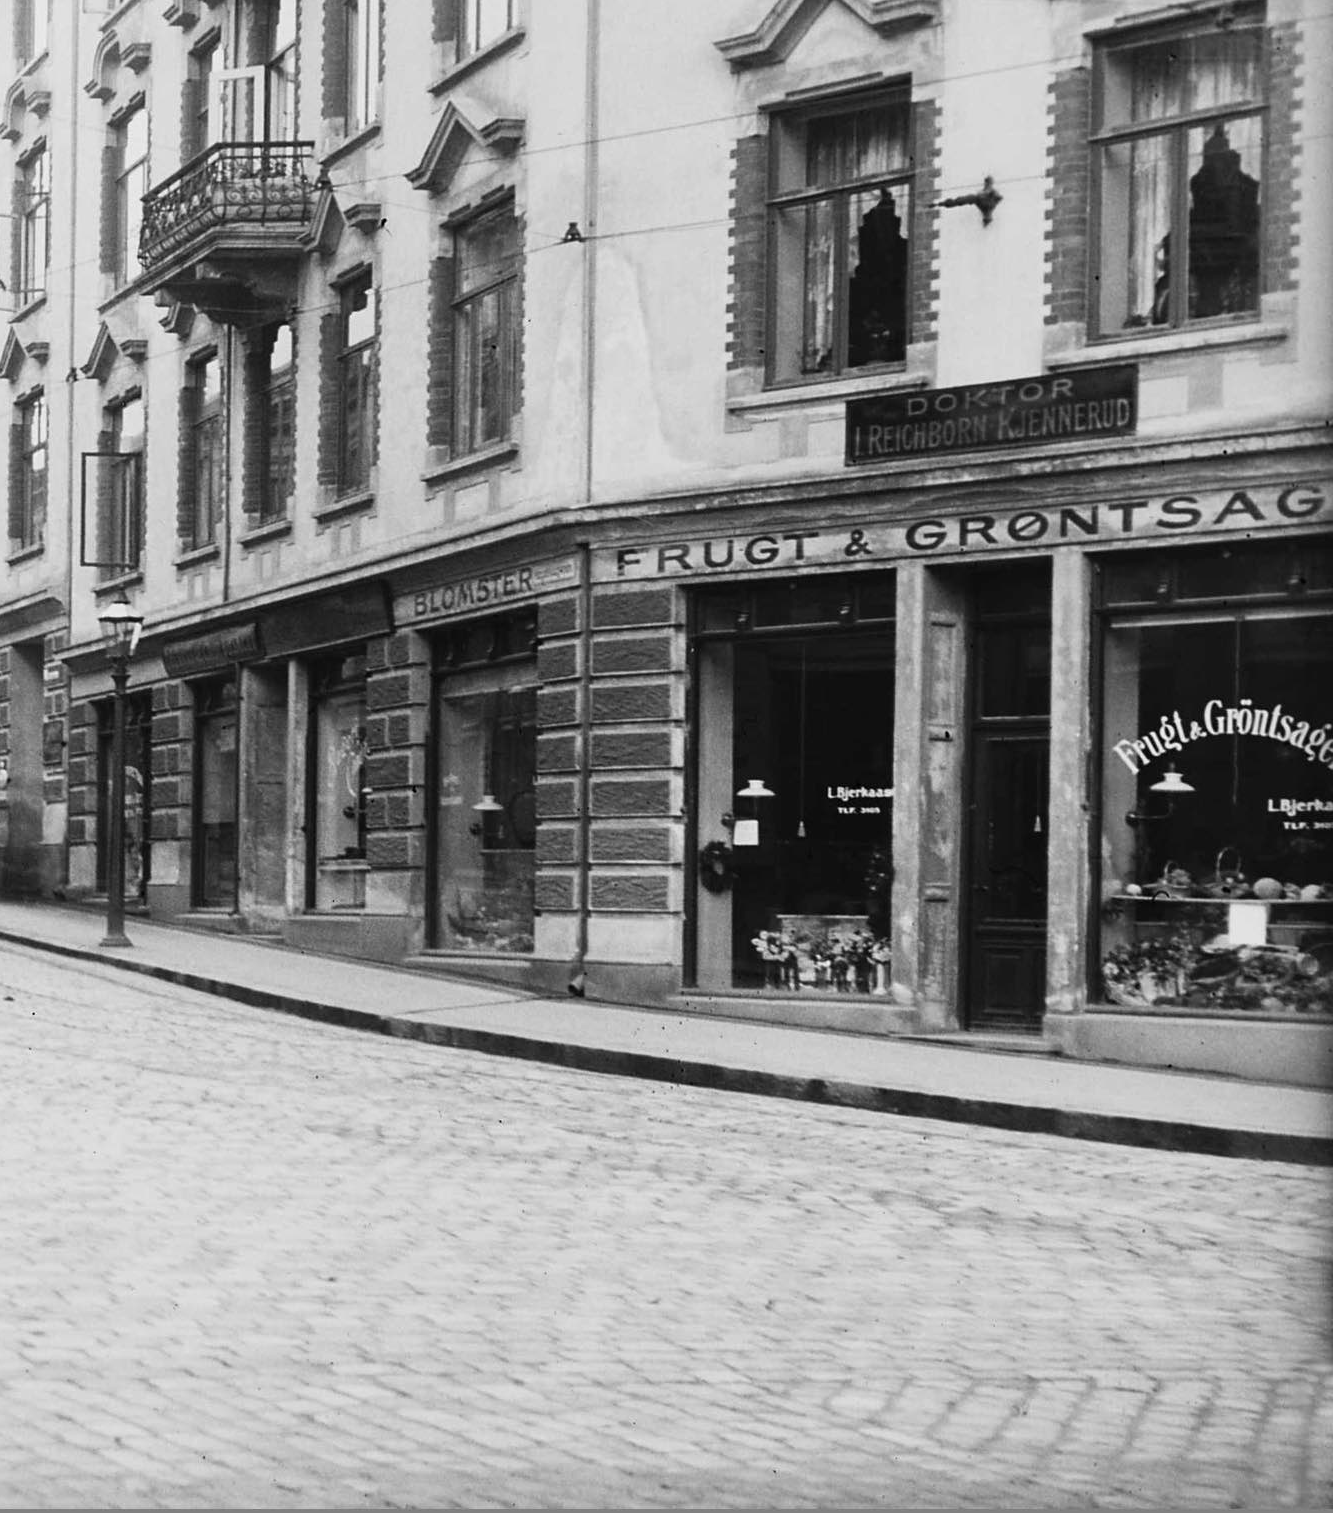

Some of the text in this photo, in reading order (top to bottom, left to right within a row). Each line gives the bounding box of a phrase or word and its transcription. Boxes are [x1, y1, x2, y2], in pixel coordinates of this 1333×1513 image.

[908, 378, 1074, 416] DOKTOR
[869, 415, 988, 455] REICHBORN
[997, 398, 1130, 440] KJENNERUD
[616, 530, 819, 577] FRUGT
[844, 529, 874, 558] &
[414, 567, 532, 616] BLOMSTER
[1112, 710, 1189, 775] Frugt
